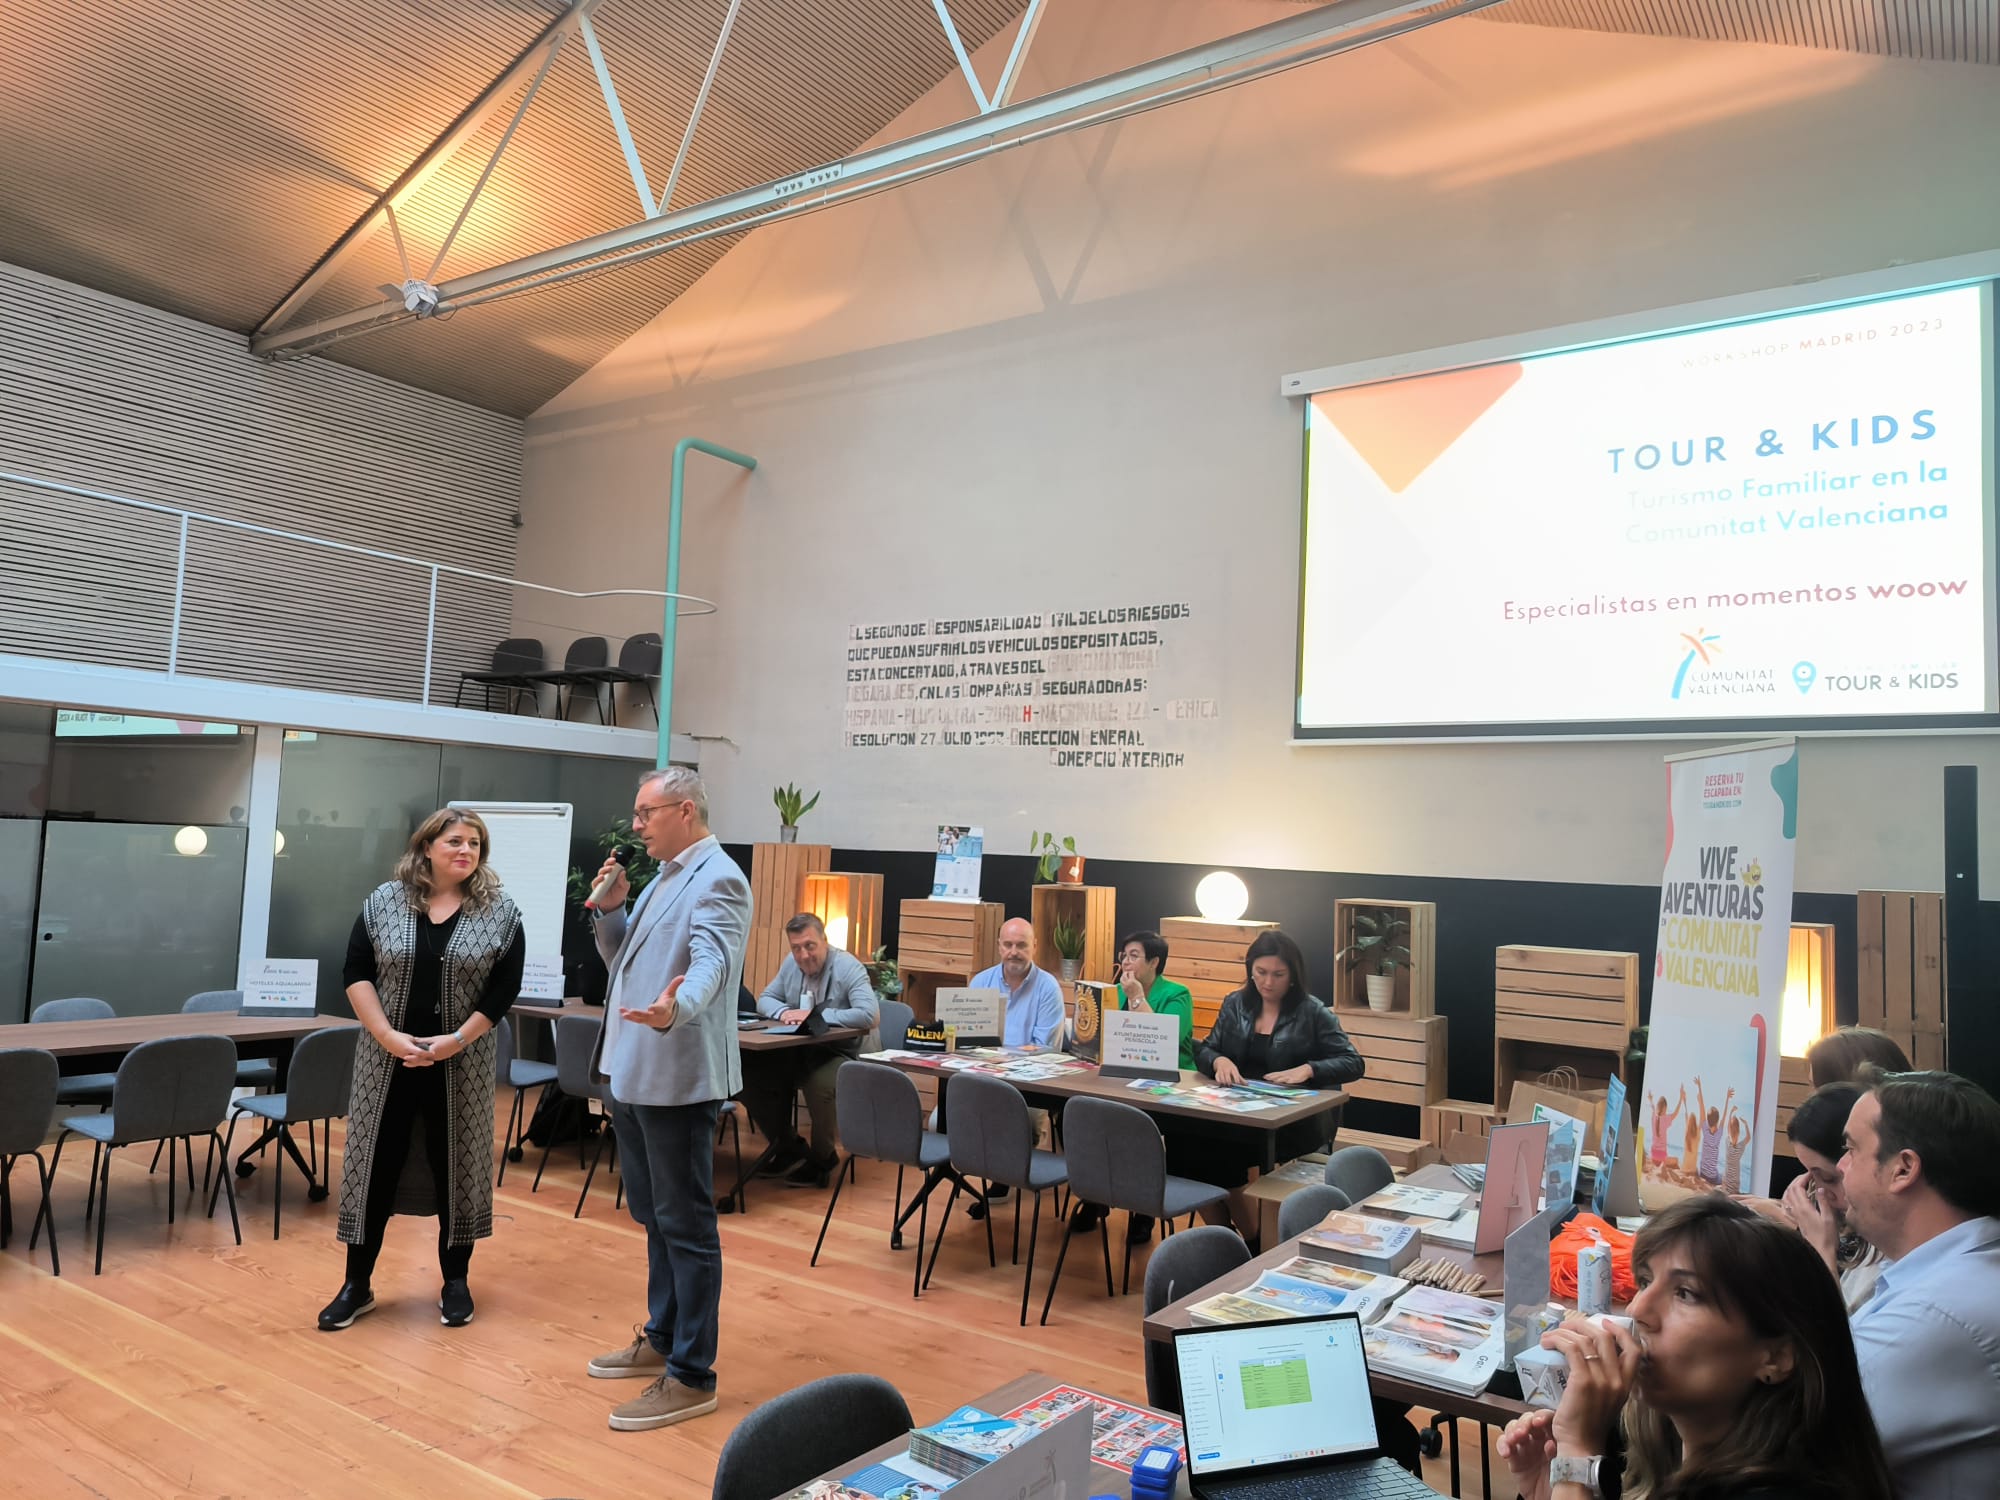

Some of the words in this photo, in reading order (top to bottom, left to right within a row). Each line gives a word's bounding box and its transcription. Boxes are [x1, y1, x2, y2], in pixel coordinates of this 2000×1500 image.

[1799, 328, 1877, 351] MADRID
[1890, 318, 1943, 337] 2023
[1607, 435, 1727, 474] TOUR
[1755, 428, 1784, 457] &
[1812, 408, 1937, 451] KIDS
[1627, 487, 1733, 510] Turismo
[1742, 470, 1862, 498] Familiar
[1871, 469, 1908, 487] en
[1919, 459, 1948, 483] la
[1624, 515, 1767, 544] Comunitat
[1776, 501, 1948, 531] Valenciana
[1503, 594, 1658, 624] Especialistas
[1666, 593, 1697, 611] en
[1707, 583, 1858, 608] momentos
[1866, 579, 1968, 600] woow
[1691, 668, 1775, 682] COMUNITAT
[1824, 674, 1882, 692] TOUR
[1889, 676, 1900, 688] &
[1908, 672, 1959, 690] KIDS
[1704, 773, 1734, 787] RESERVA
[1735, 771, 1744, 784] TU
[1699, 845, 1738, 881] VIVE
[1663, 881, 1765, 921] AVENTURAS
[1666, 916, 1763, 960] COMUNITAT
[1665, 950, 1760, 998] VALENCIANA
[907, 1027, 946, 1041] VILLENA
